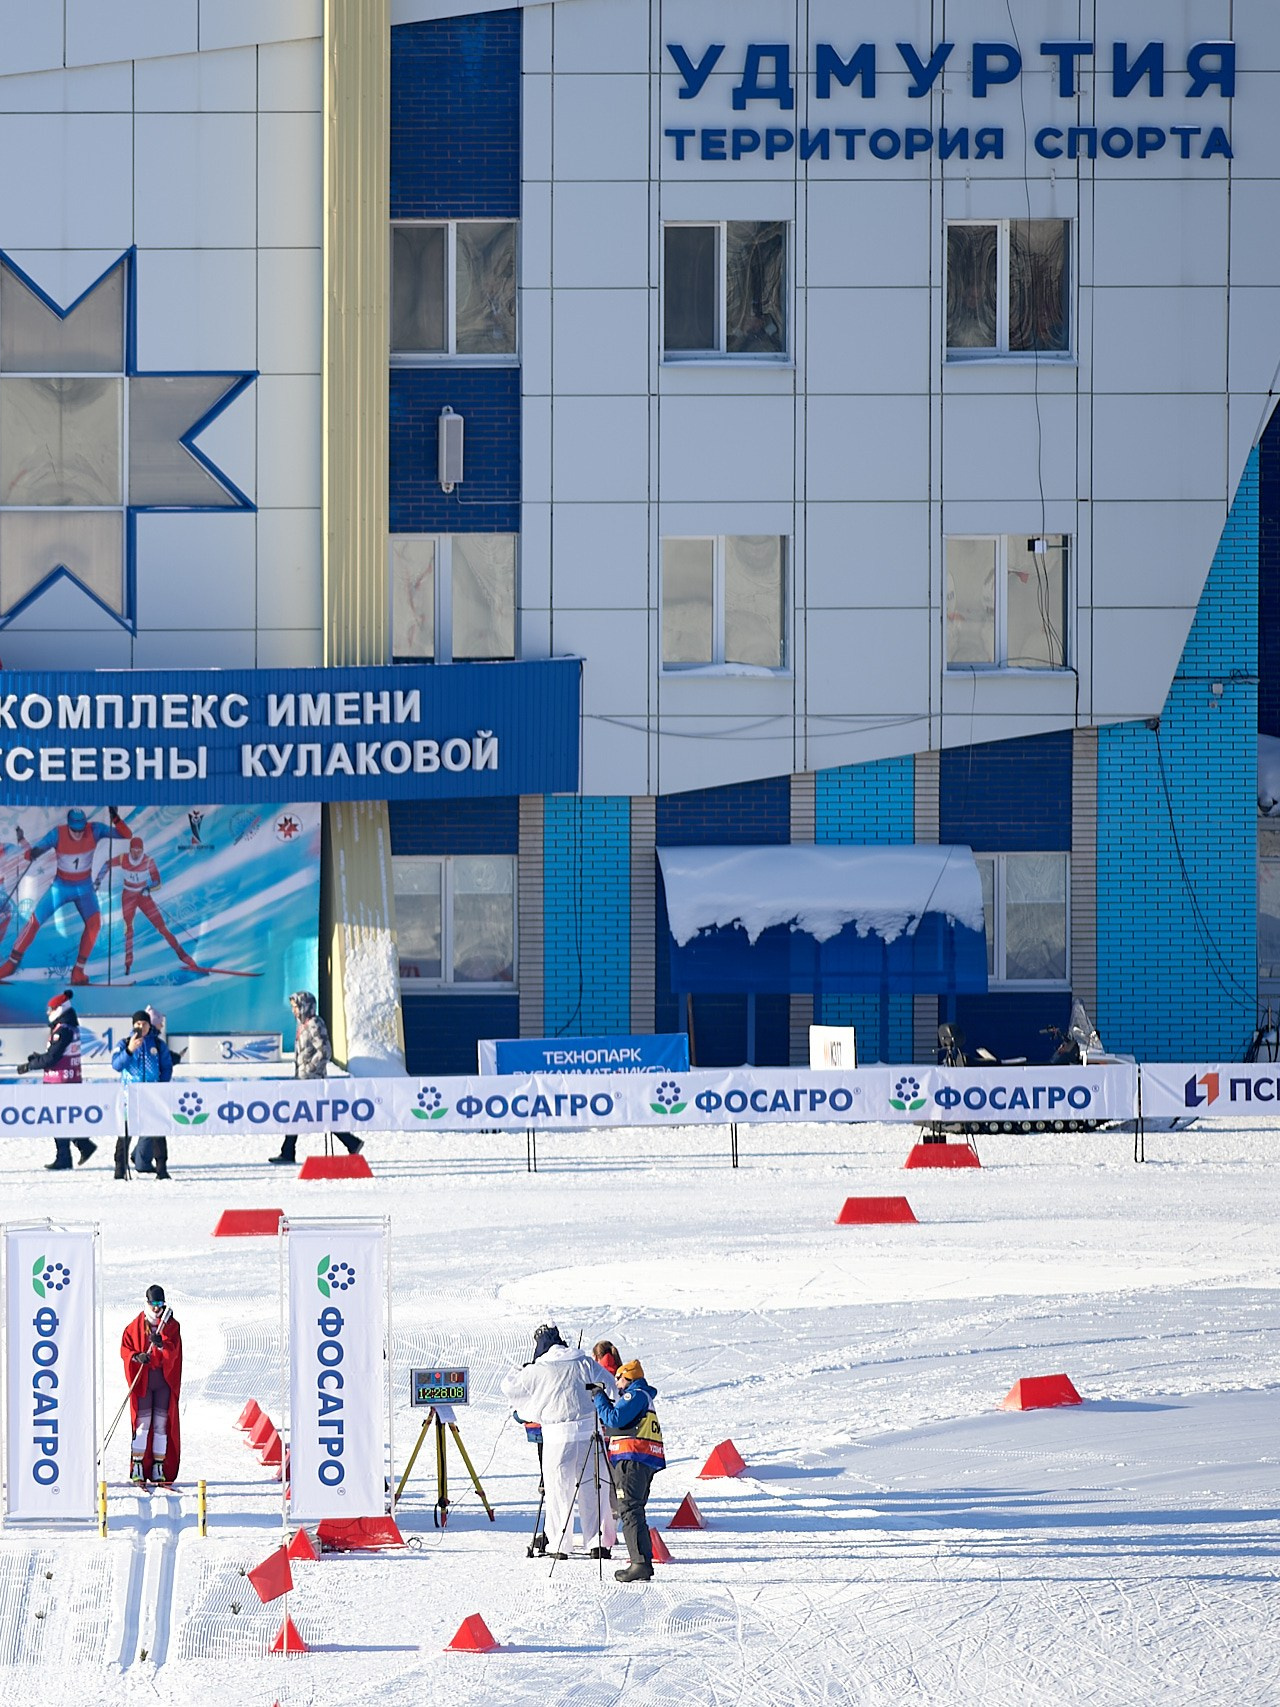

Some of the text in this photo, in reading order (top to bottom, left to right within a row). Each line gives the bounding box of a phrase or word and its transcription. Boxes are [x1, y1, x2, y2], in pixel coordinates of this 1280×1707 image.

[666, 40, 1236, 111] УДМУРТИЯ
[664, 125, 1234, 161] ТЕРРИТОРИЯ СПОРТА
[267, 689, 421, 728] ИМЕНИ
[241, 730, 499, 778] КУЛАКОВОЙ
[73, 857, 79, 870] 1
[102, 1027, 113, 1053] 1
[222, 1040, 233, 1060] 3
[542, 1048, 642, 1065] ТЕХНОПАРК
[63, 1069, 74, 1079] 39
[694, 1086, 853, 1113] ФОСАГРО
[934, 1085, 1092, 1110] ФОСАГРО
[1229, 1077, 1280, 1102] ПС
[217, 1098, 375, 1125] ФОСАГРО
[456, 1092, 615, 1119] ФОСАГРО
[32, 1306, 60, 1486] ФОСАГРО
[317, 1306, 345, 1487] ФОСАГРО
